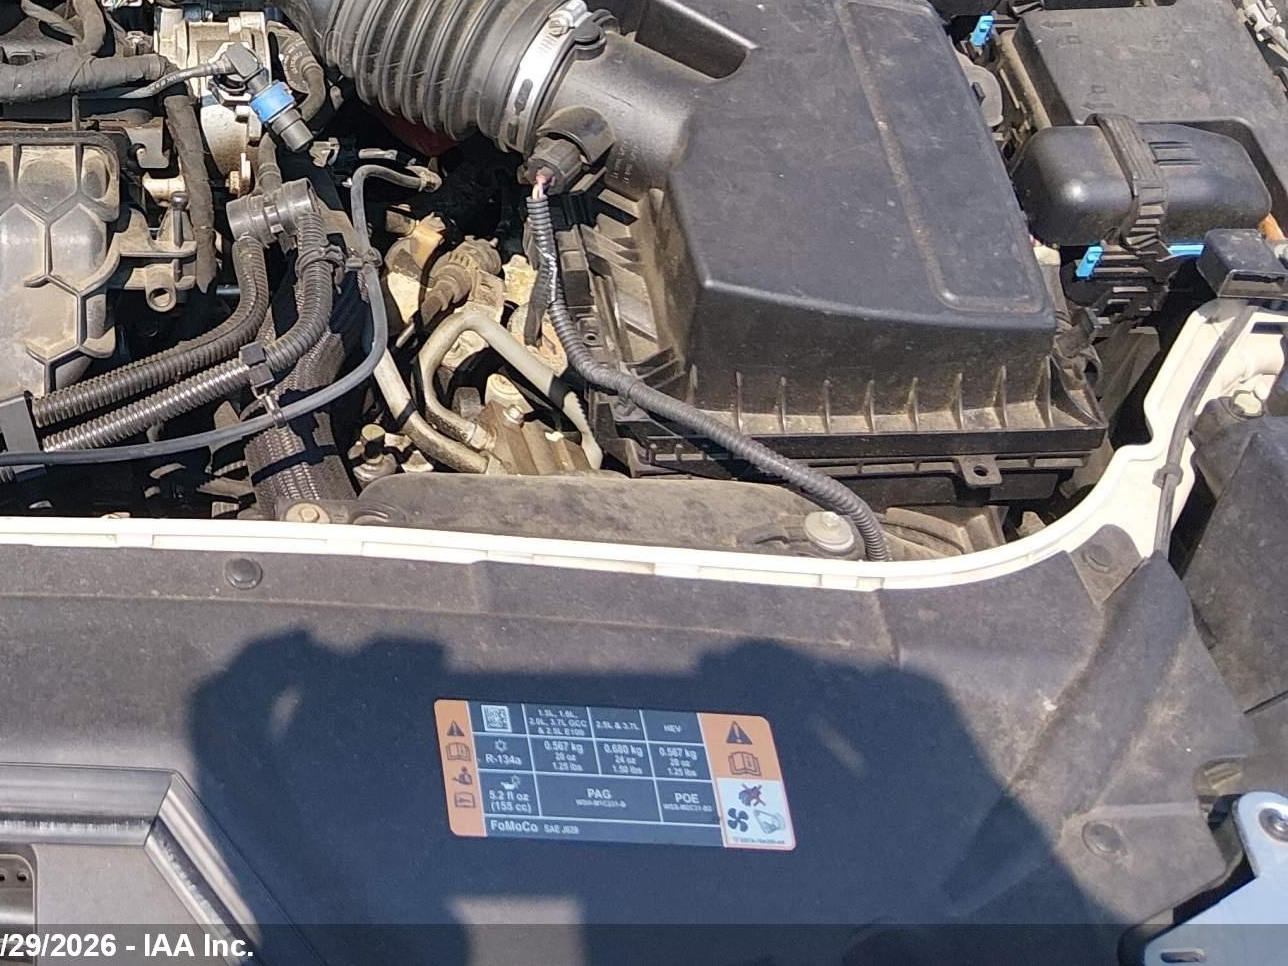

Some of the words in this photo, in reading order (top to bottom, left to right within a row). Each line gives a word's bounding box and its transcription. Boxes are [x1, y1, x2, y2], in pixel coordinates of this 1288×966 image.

[663, 724, 682, 733] HEV
[571, 741, 584, 755] kg
[630, 744, 644, 758] kg
[684, 747, 698, 761] kg
[485, 753, 523, 765] R-134a
[566, 754, 577, 762] oz
[488, 789, 505, 801] 5.2
[506, 790, 515, 801] fl
[516, 792, 530, 802] oz
[587, 788, 612, 800] PAG
[673, 792, 700, 804] POE
[490, 801, 513, 813] (155
[514, 803, 532, 814] cc)
[490, 820, 539, 833] FoMoCo
[543, 823, 561, 834] SAE
